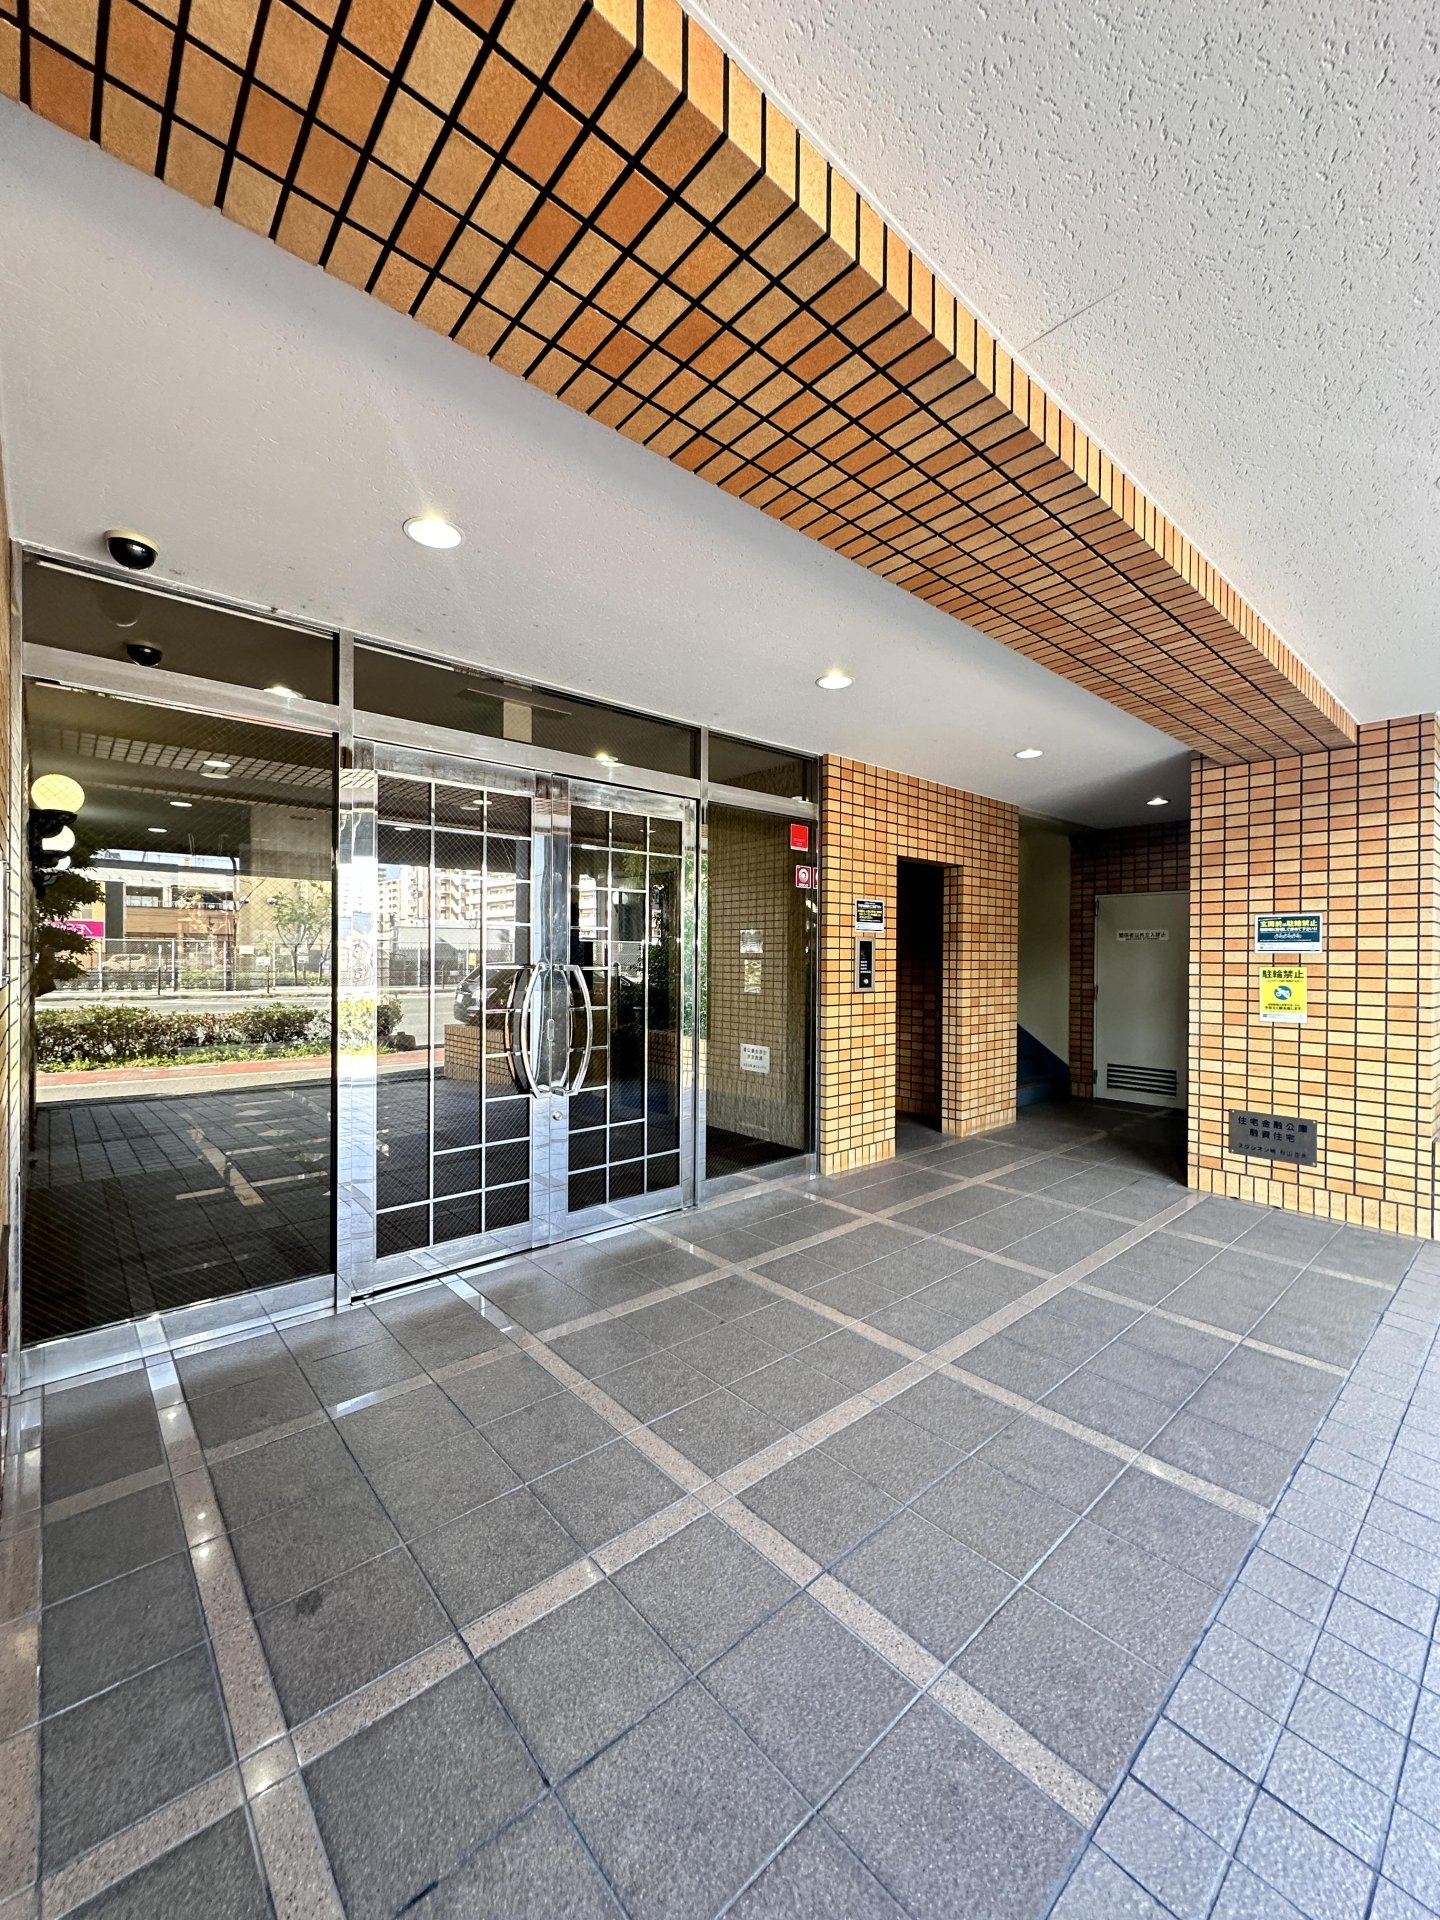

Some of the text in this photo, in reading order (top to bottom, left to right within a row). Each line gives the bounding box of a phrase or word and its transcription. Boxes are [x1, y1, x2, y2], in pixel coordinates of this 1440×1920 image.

[1262, 969, 1304, 979] 駐輪禁止
[1238, 1116, 1308, 1133] 住宅金融公庫
[1249, 1129, 1295, 1142] 融資住宅
